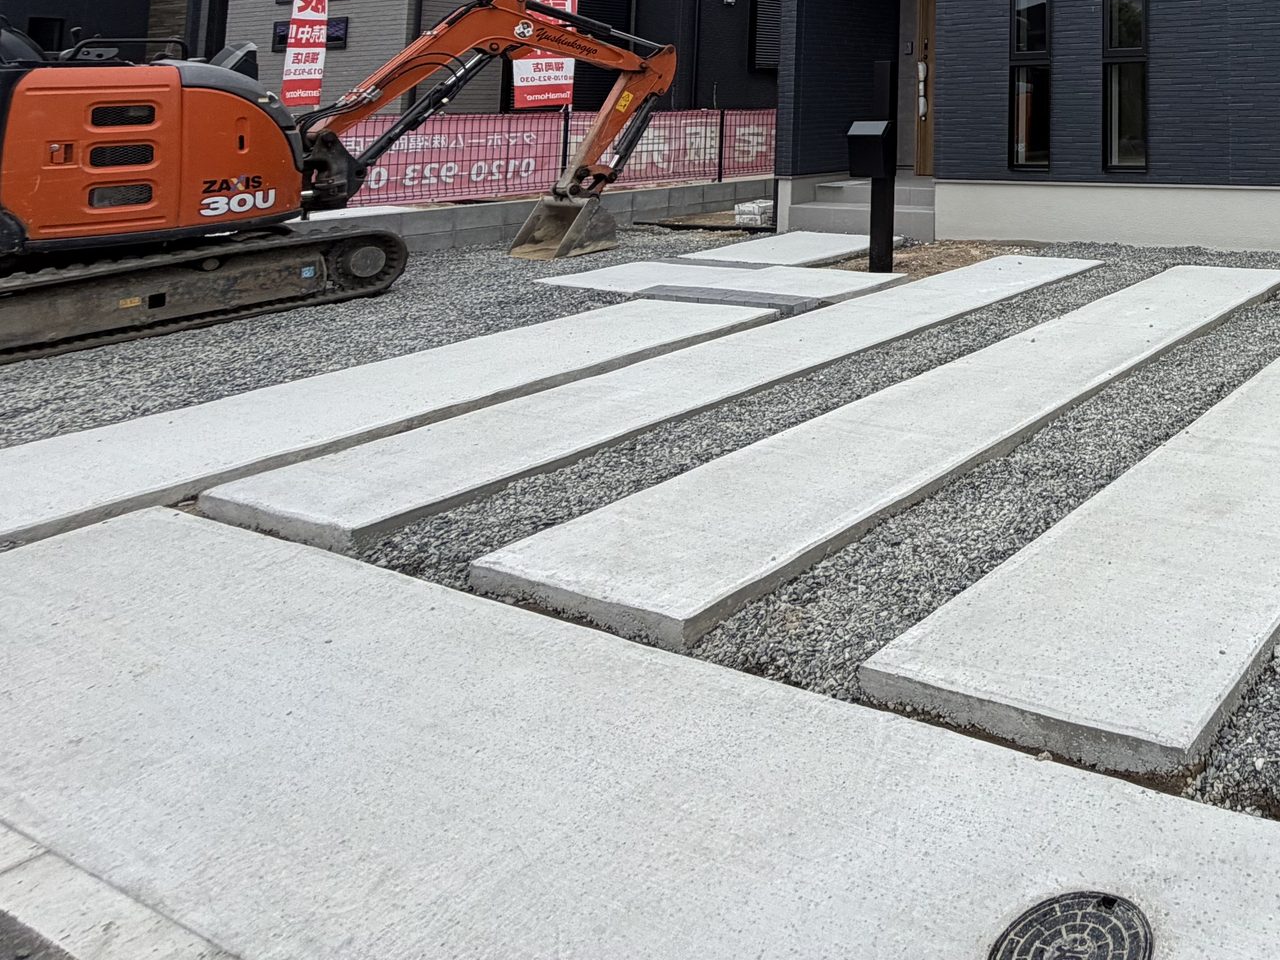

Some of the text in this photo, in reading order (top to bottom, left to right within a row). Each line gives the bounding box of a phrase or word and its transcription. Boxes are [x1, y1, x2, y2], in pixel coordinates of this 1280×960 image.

[535, 27, 598, 56] Yushinkogyo
[202, 175, 264, 195] ZAXIS
[199, 188, 277, 217] 30U
